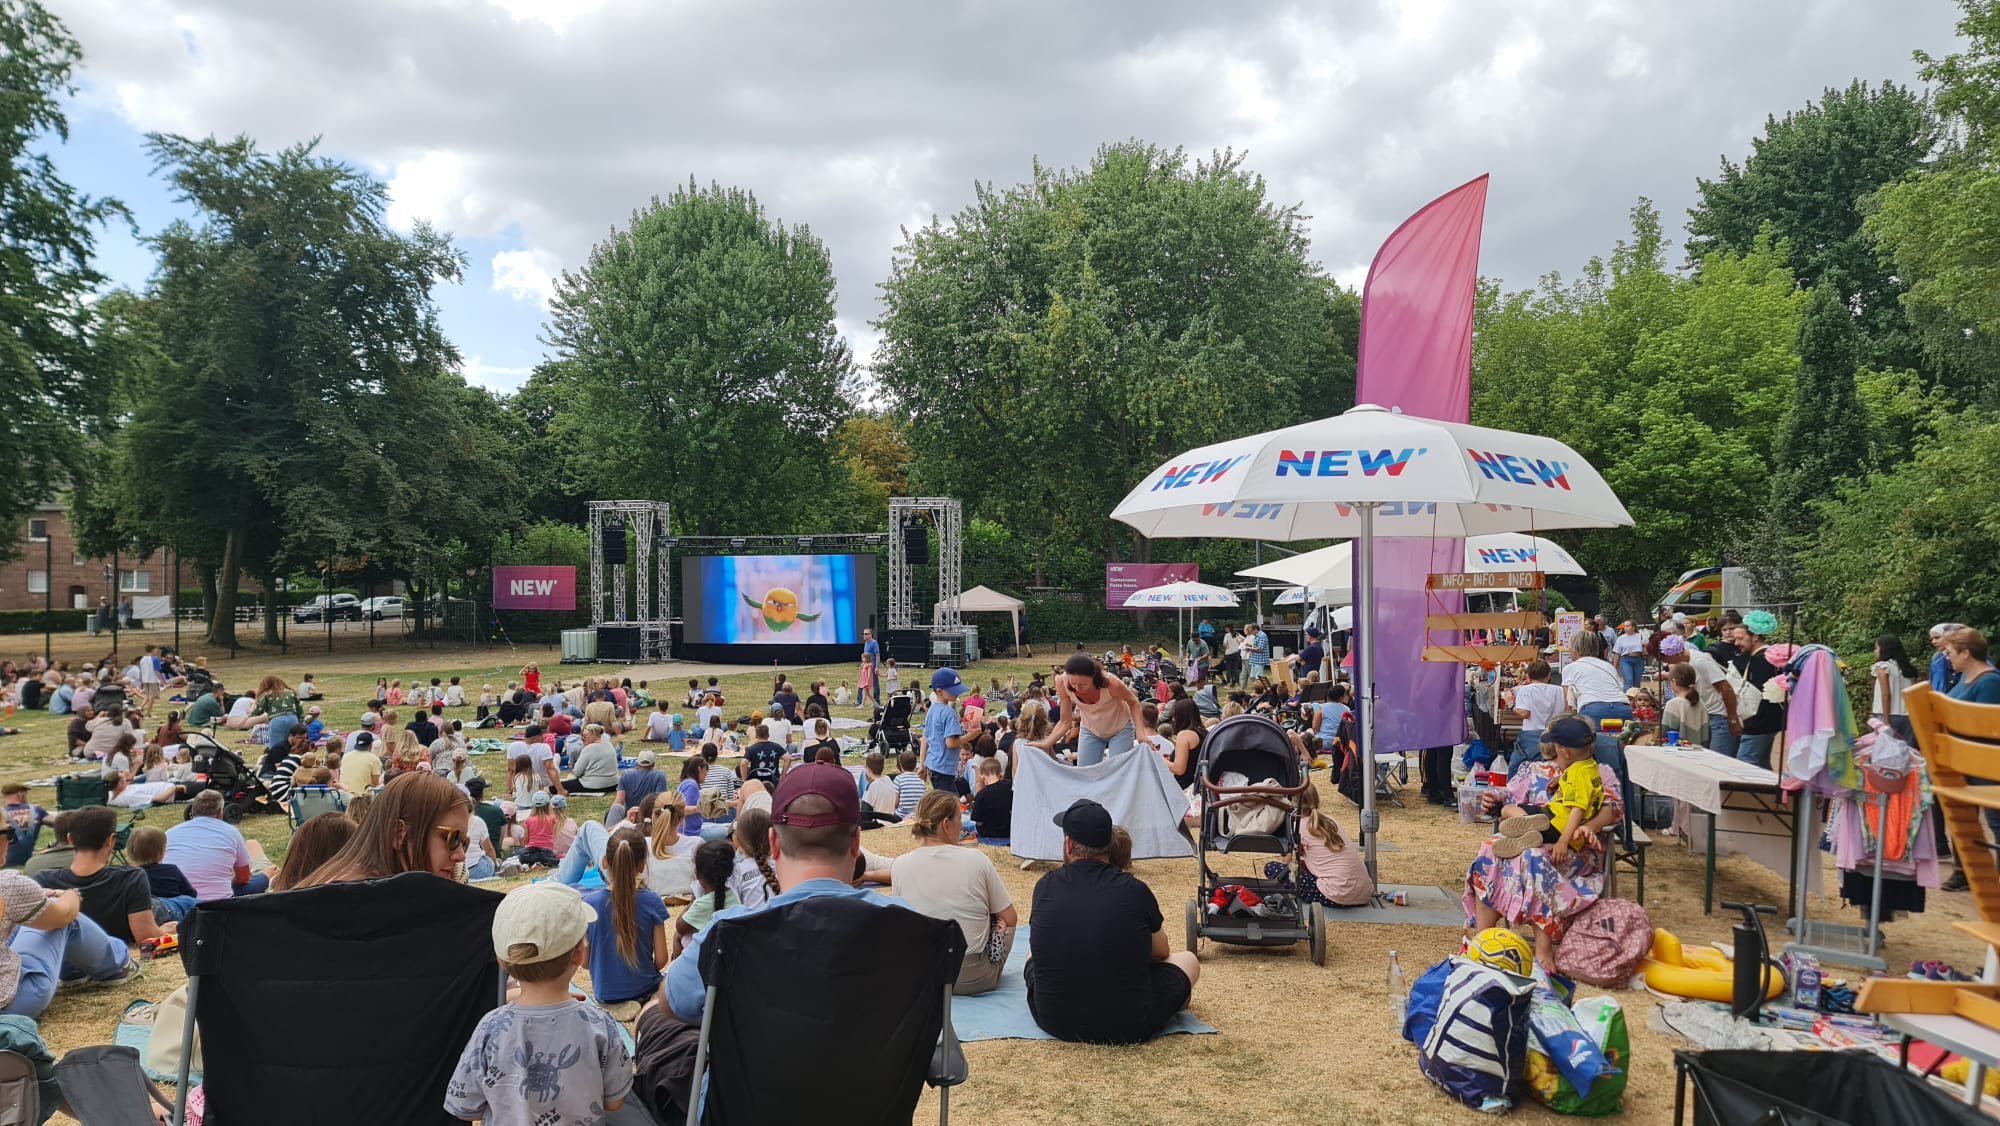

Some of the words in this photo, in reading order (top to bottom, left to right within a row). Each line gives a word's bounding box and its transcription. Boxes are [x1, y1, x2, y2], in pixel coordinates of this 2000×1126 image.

[1442, 573, 1464, 586] INFO
[1473, 573, 1495, 586] INFO
[1508, 573, 1533, 586] INFO
